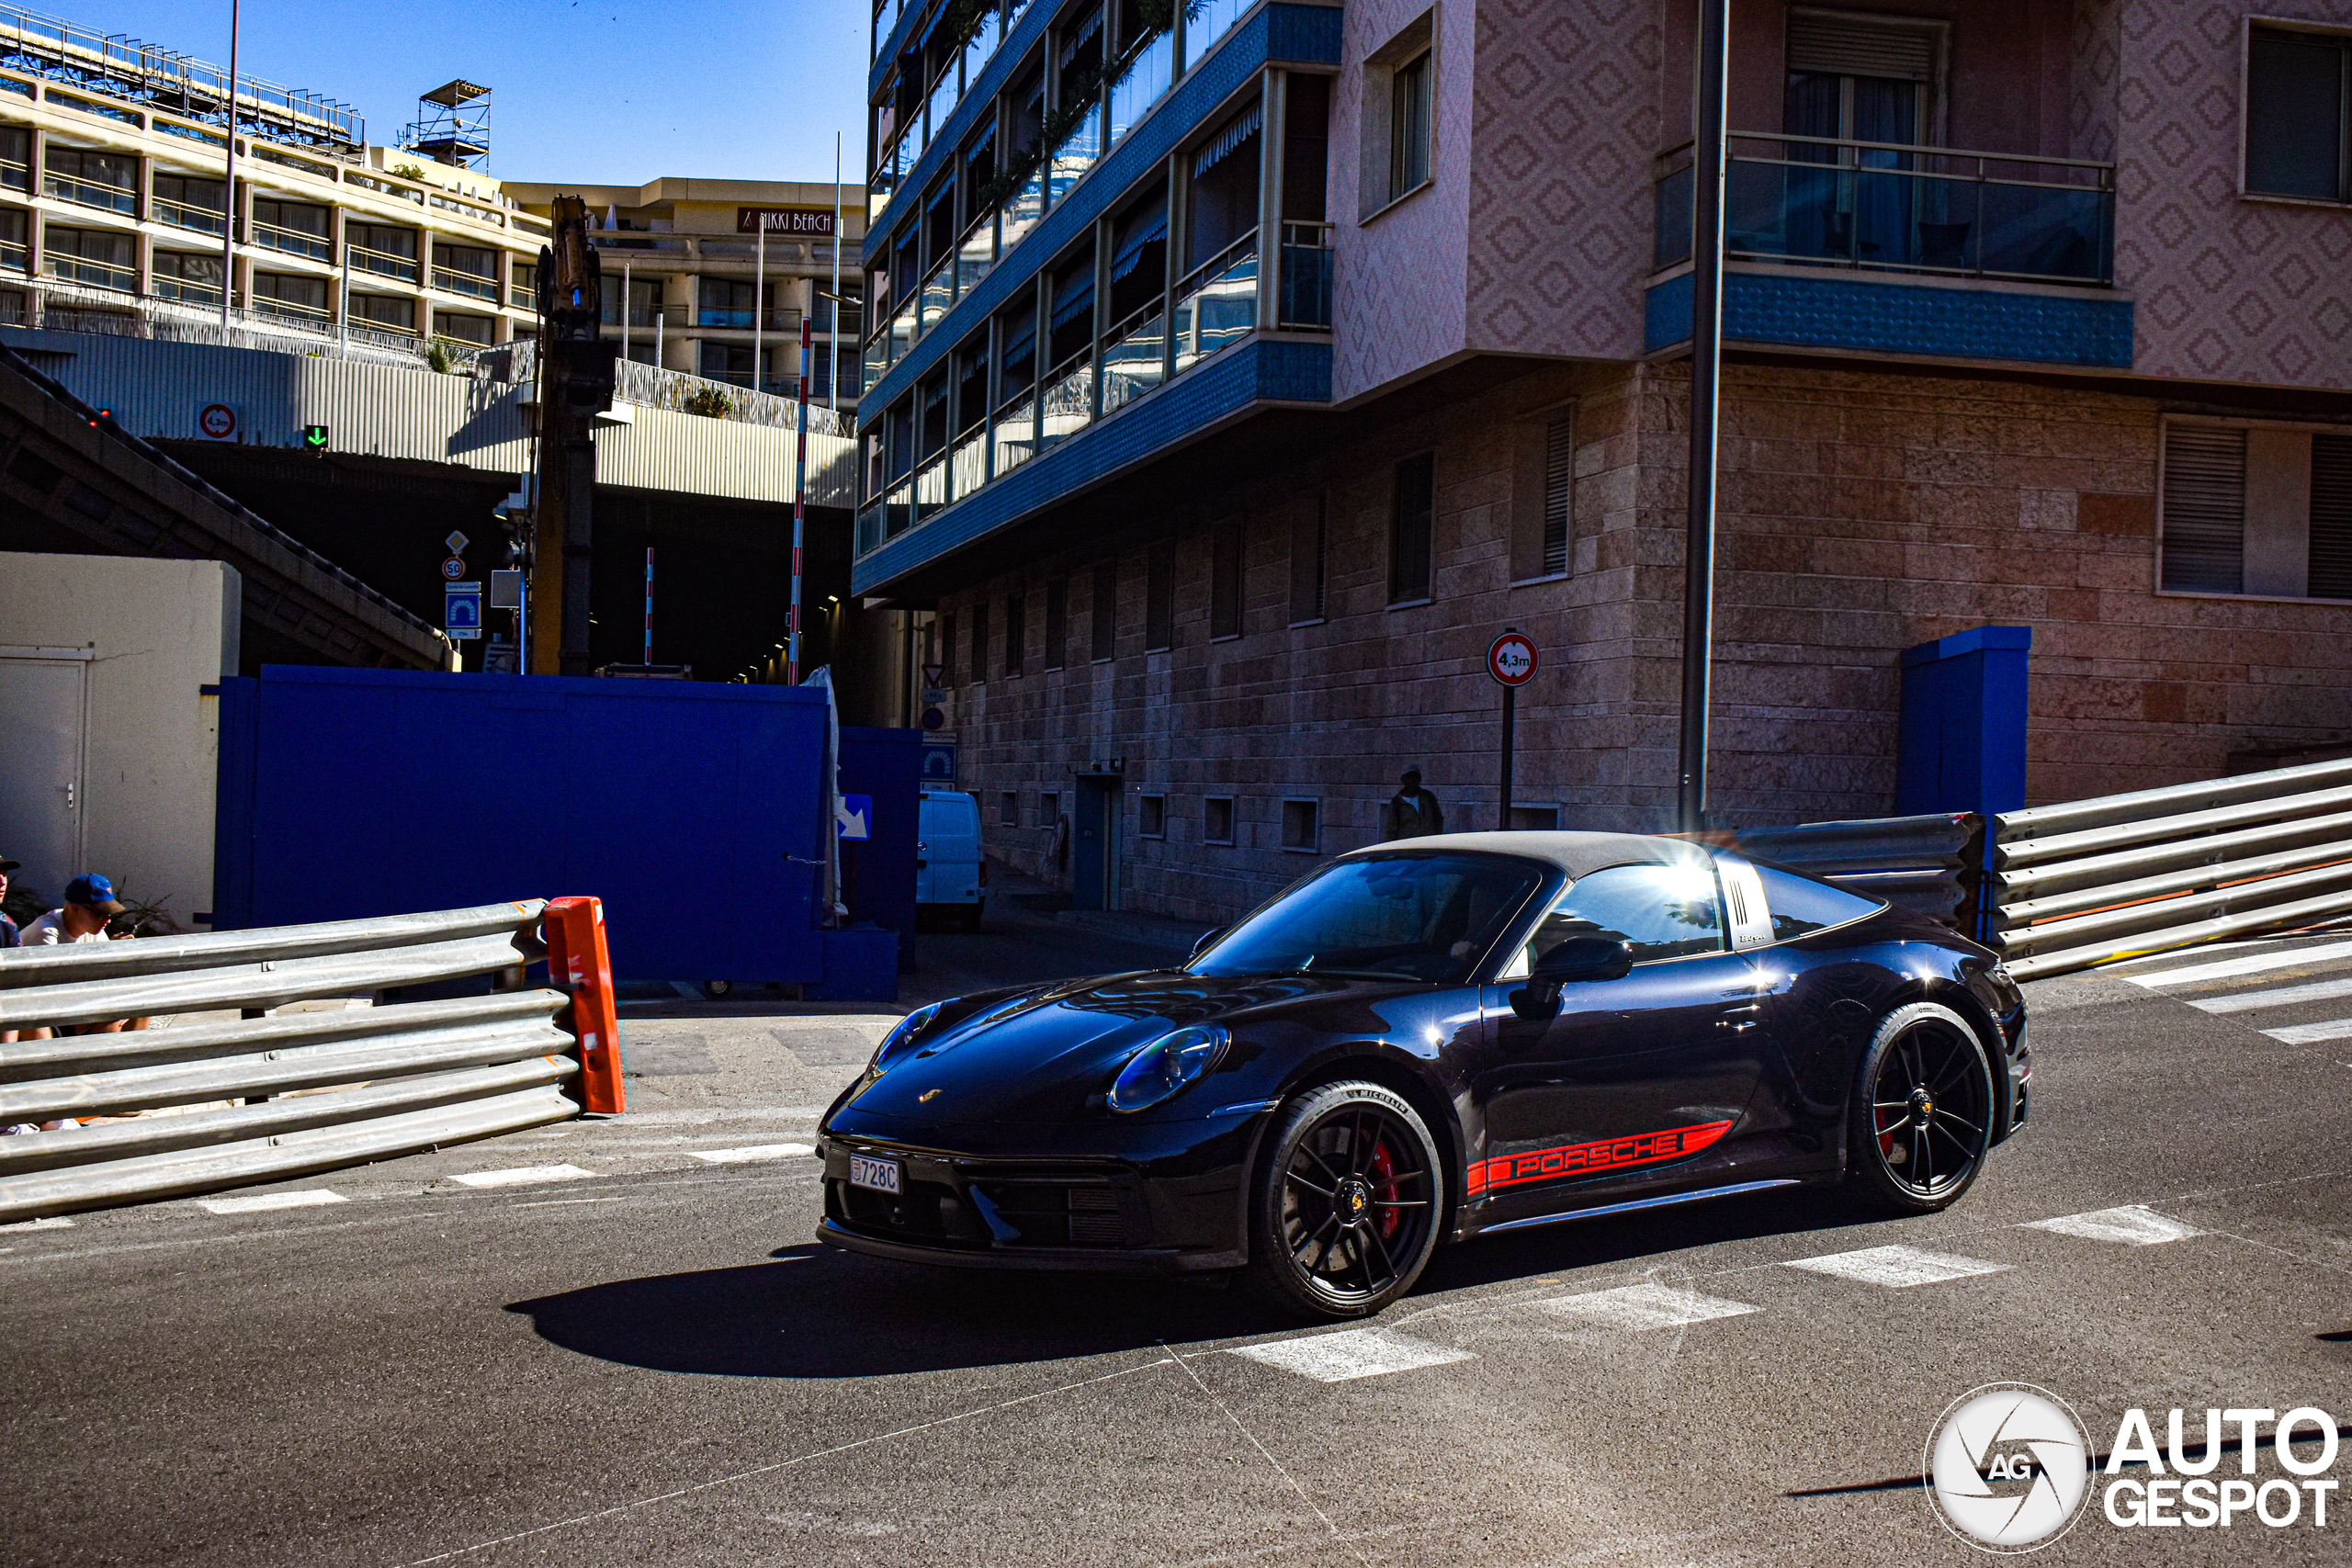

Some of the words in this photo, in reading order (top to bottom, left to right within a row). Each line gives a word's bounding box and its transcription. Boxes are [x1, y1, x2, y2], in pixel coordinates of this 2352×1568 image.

[760, 211, 789, 230] NIKKI
[793, 213, 831, 231] BEACH
[207, 416, 229, 427] 4,3m
[447, 564, 460, 573] 50
[1498, 652, 1530, 668] 4,3m
[1361, 1090, 1407, 1112] MICHELIN
[1516, 1134, 1677, 1177] PORSCHE
[861, 1160, 896, 1189] 728C
